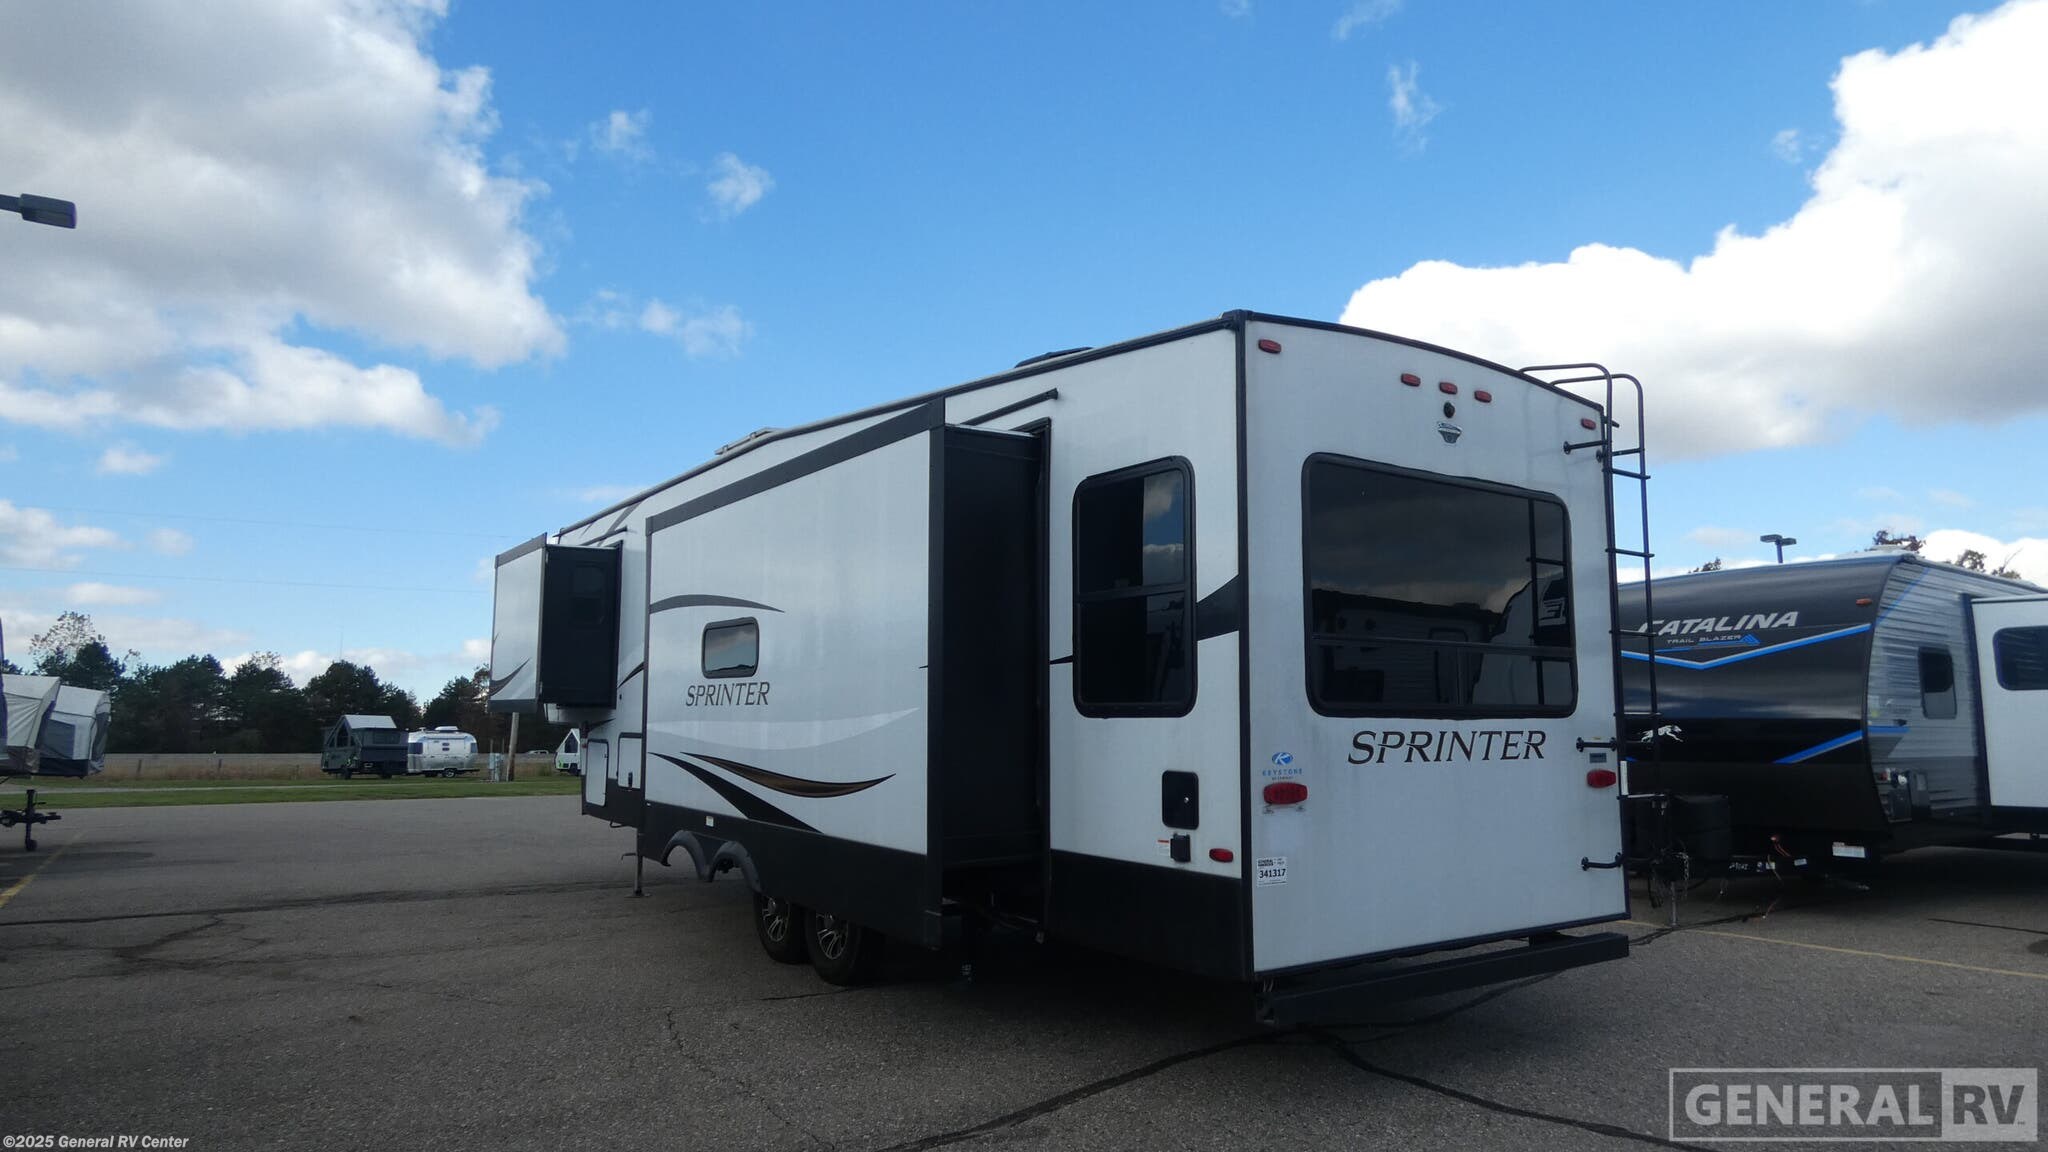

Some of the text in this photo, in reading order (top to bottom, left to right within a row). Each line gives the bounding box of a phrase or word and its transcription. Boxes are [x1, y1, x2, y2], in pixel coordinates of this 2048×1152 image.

[1637, 611, 1799, 636] CATALINA
[1699, 634, 1742, 642] BLAZER
[685, 681, 770, 707] SPRINTER
[1347, 730, 1547, 765] SPRINTER
[1262, 768, 1303, 777] KEYSTONE
[1259, 868, 1286, 879] 341317
